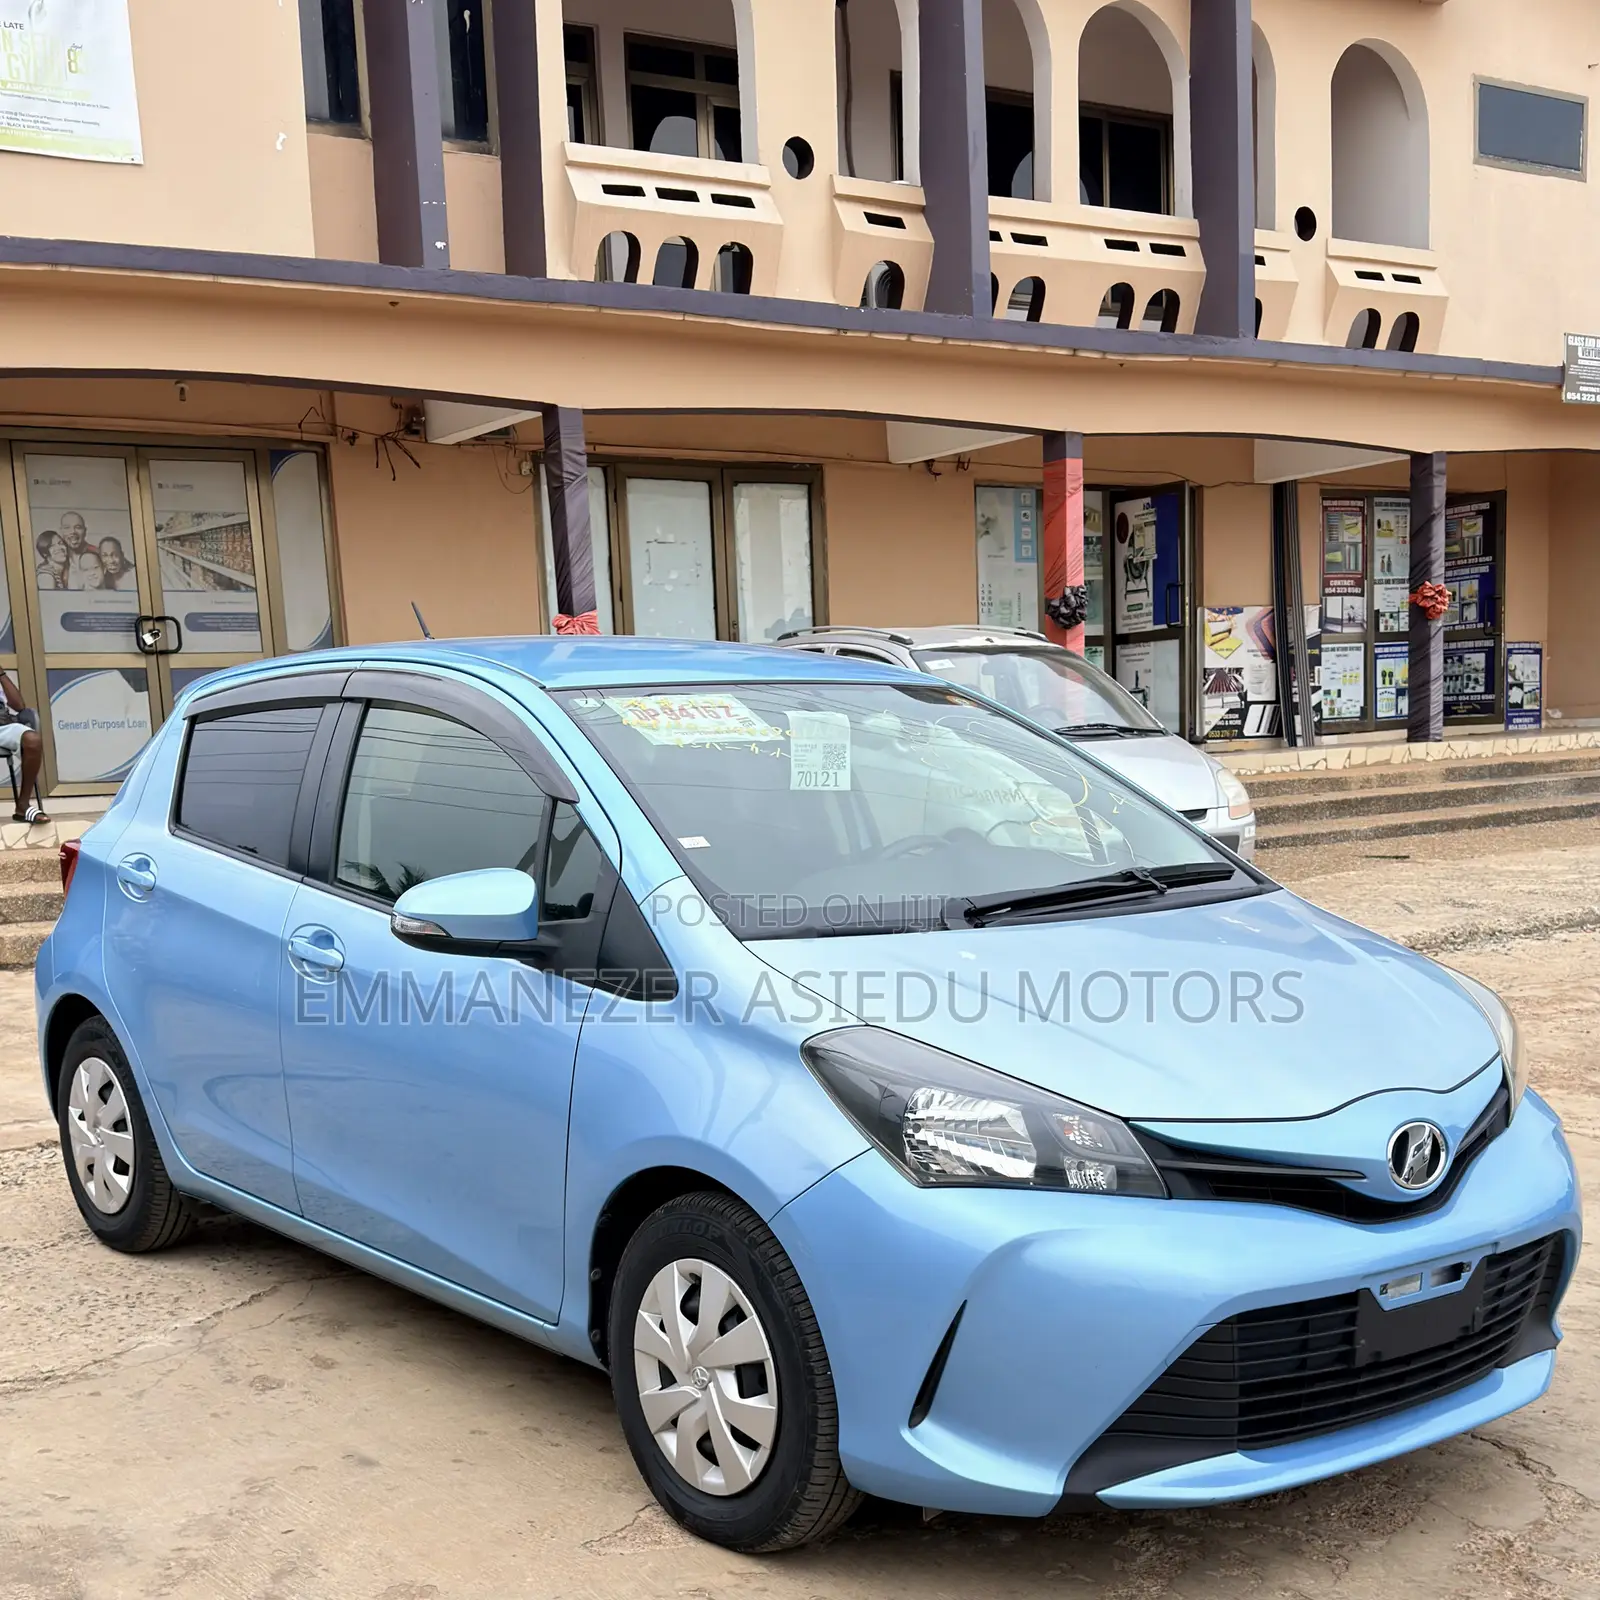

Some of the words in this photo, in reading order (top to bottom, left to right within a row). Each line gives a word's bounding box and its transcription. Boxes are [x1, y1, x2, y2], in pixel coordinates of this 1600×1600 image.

[3, 21, 24, 30] LATE
[1566, 391, 1580, 400] 054
[57, 719, 90, 730] General
[92, 719, 126, 732] Purpose
[127, 718, 147, 729] Loan
[797, 770, 840, 788] 70121
